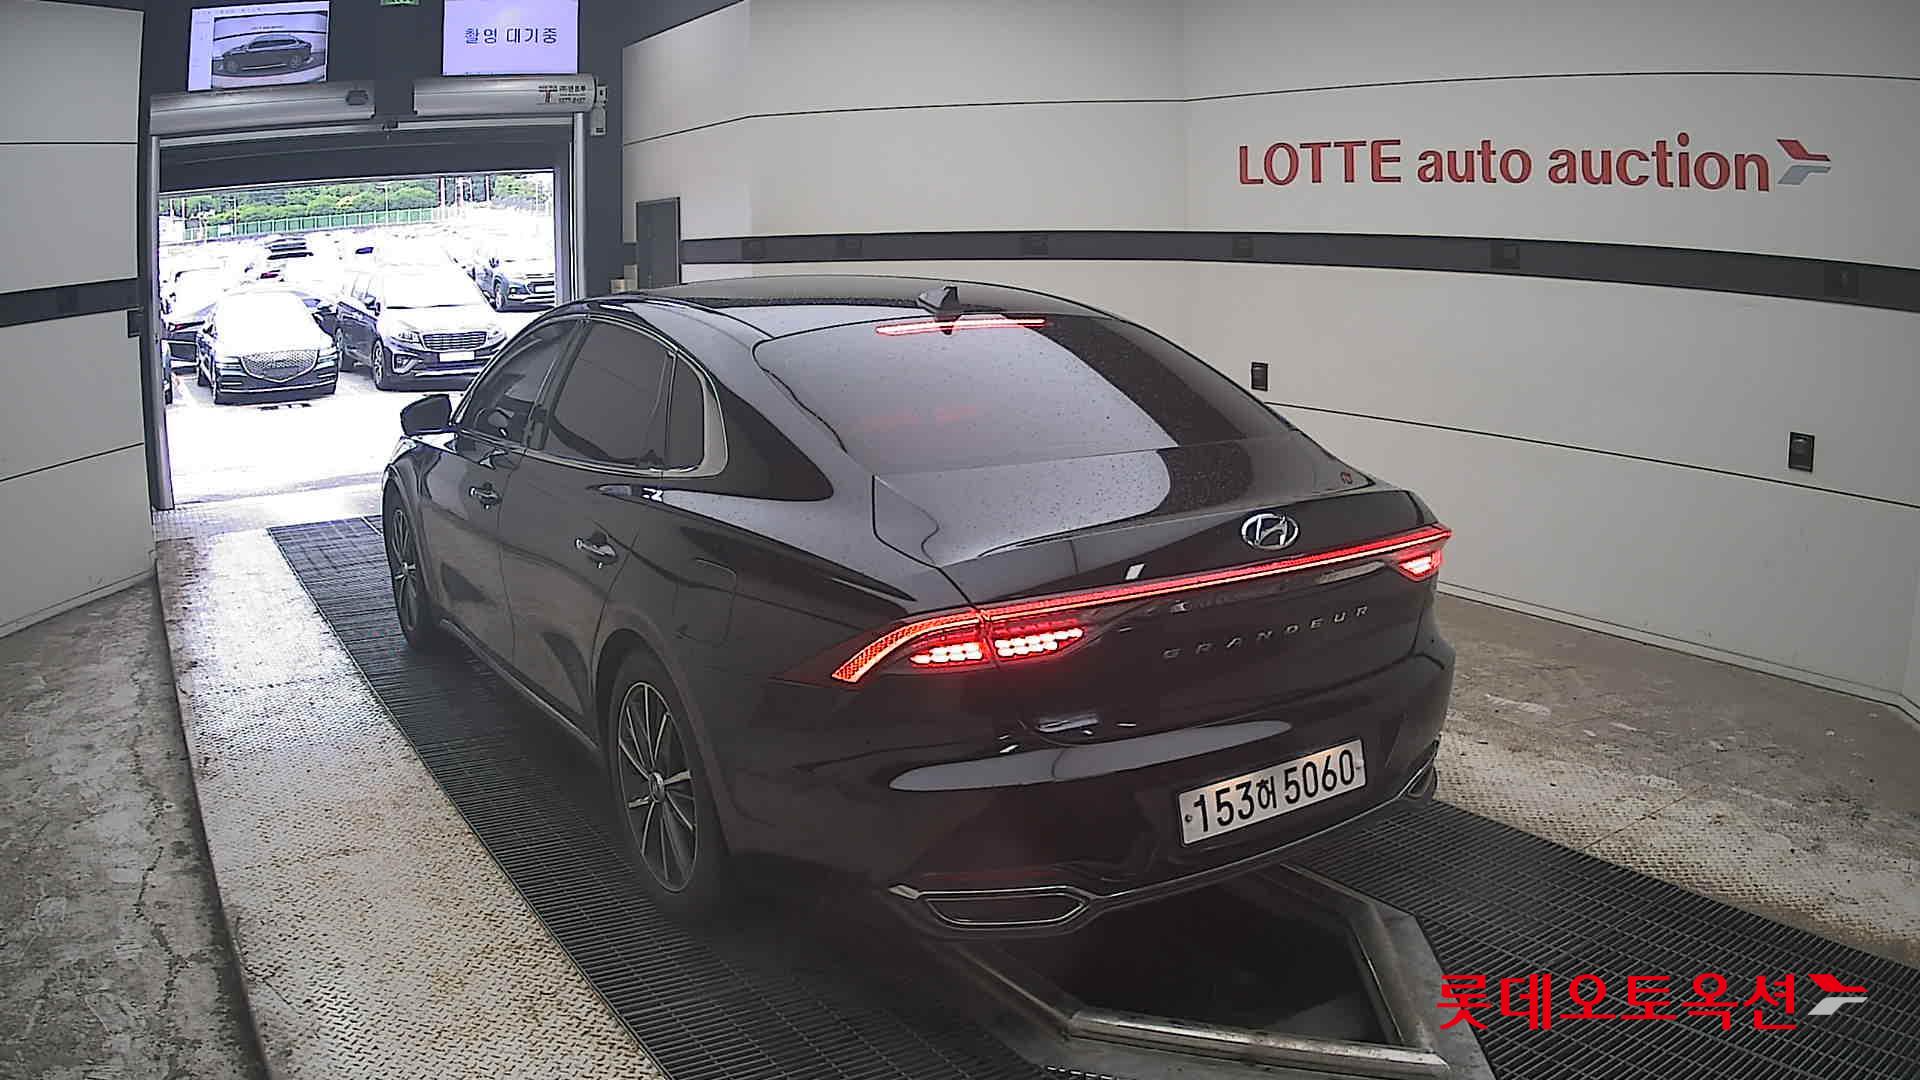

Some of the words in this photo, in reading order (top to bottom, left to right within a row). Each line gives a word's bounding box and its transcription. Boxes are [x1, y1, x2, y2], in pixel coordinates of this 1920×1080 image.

[506, 27, 557, 44] 대기중
[1239, 138, 1400, 186] LOTTE
[1416, 139, 1532, 185] auto
[1547, 132, 1770, 192] auction
[1162, 605, 1369, 658] GRANDEUR
